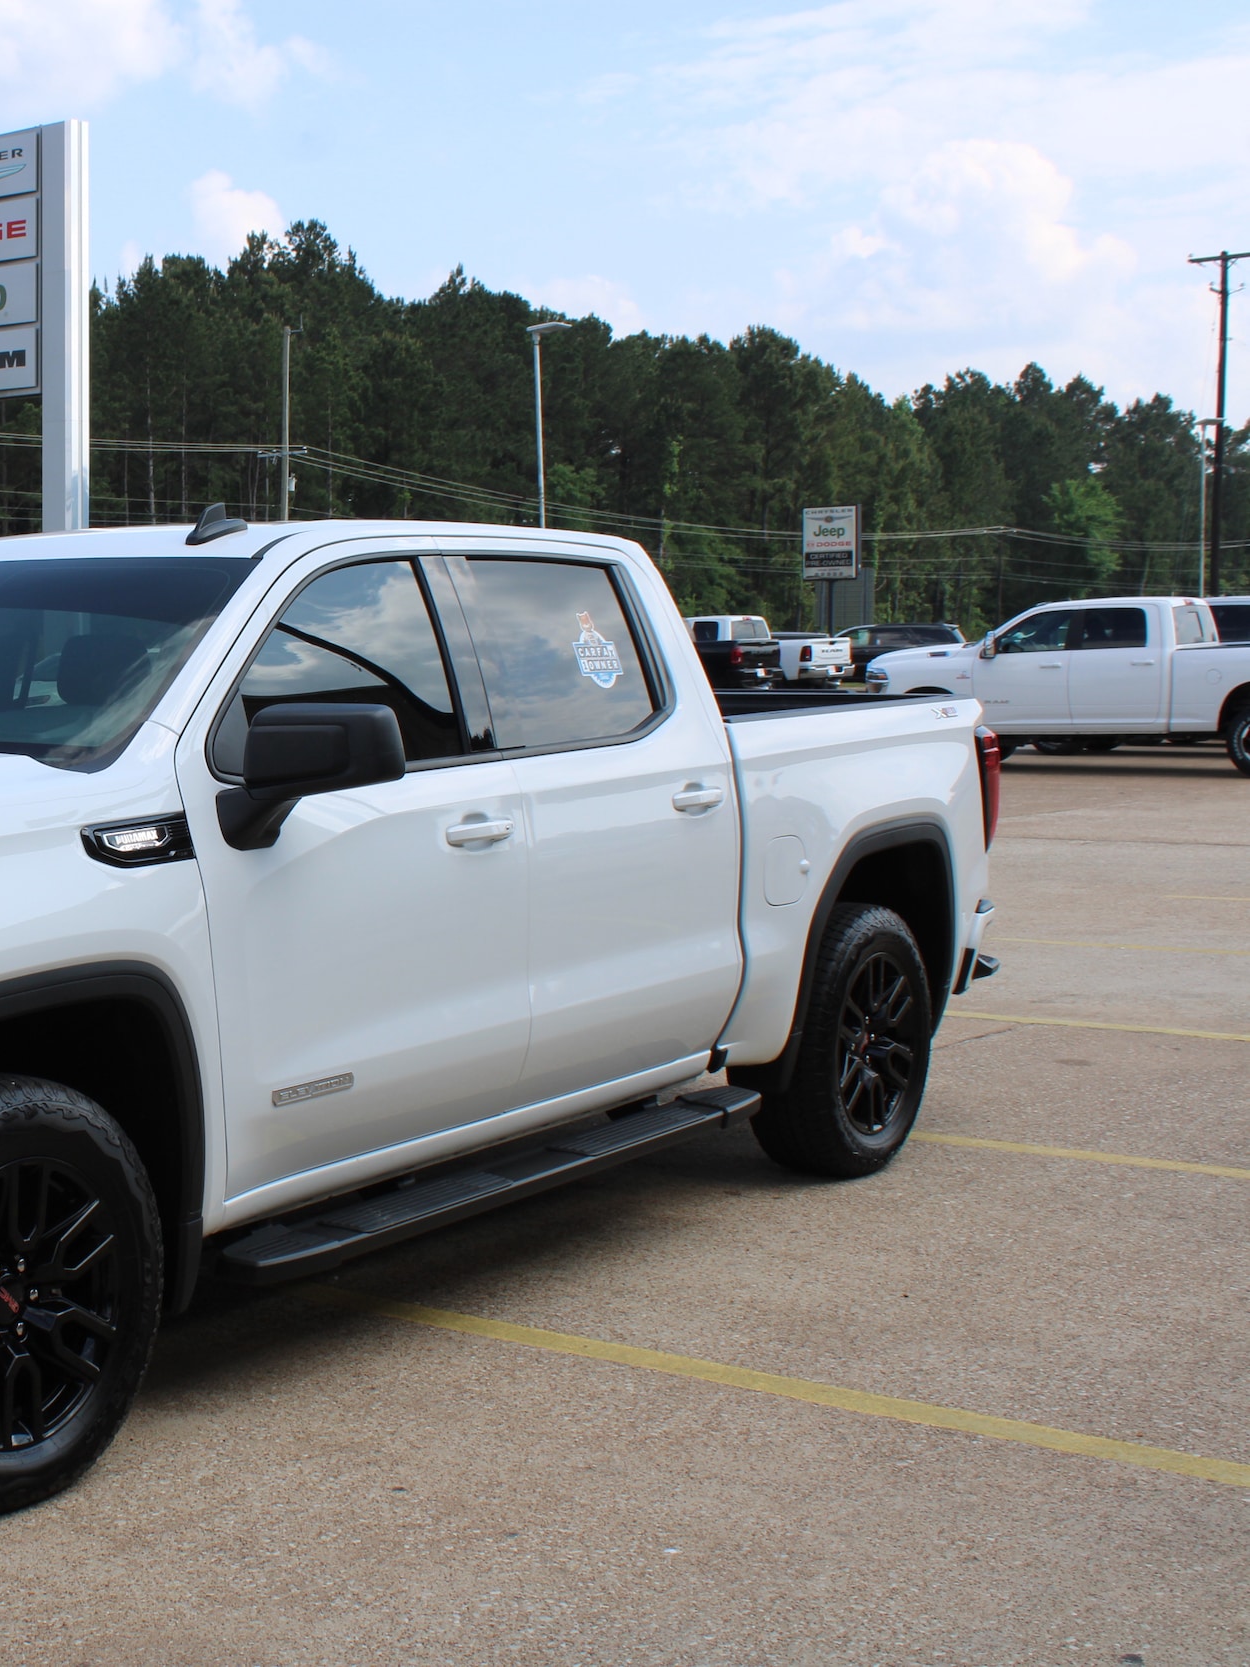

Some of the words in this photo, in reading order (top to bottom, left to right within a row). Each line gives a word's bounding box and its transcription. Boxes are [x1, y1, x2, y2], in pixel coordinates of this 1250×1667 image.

[813, 525, 846, 538] Jeep
[810, 552, 848, 560] CERTIFIED
[588, 660, 619, 671] OWNER
[115, 830, 159, 845] DURAMAX
